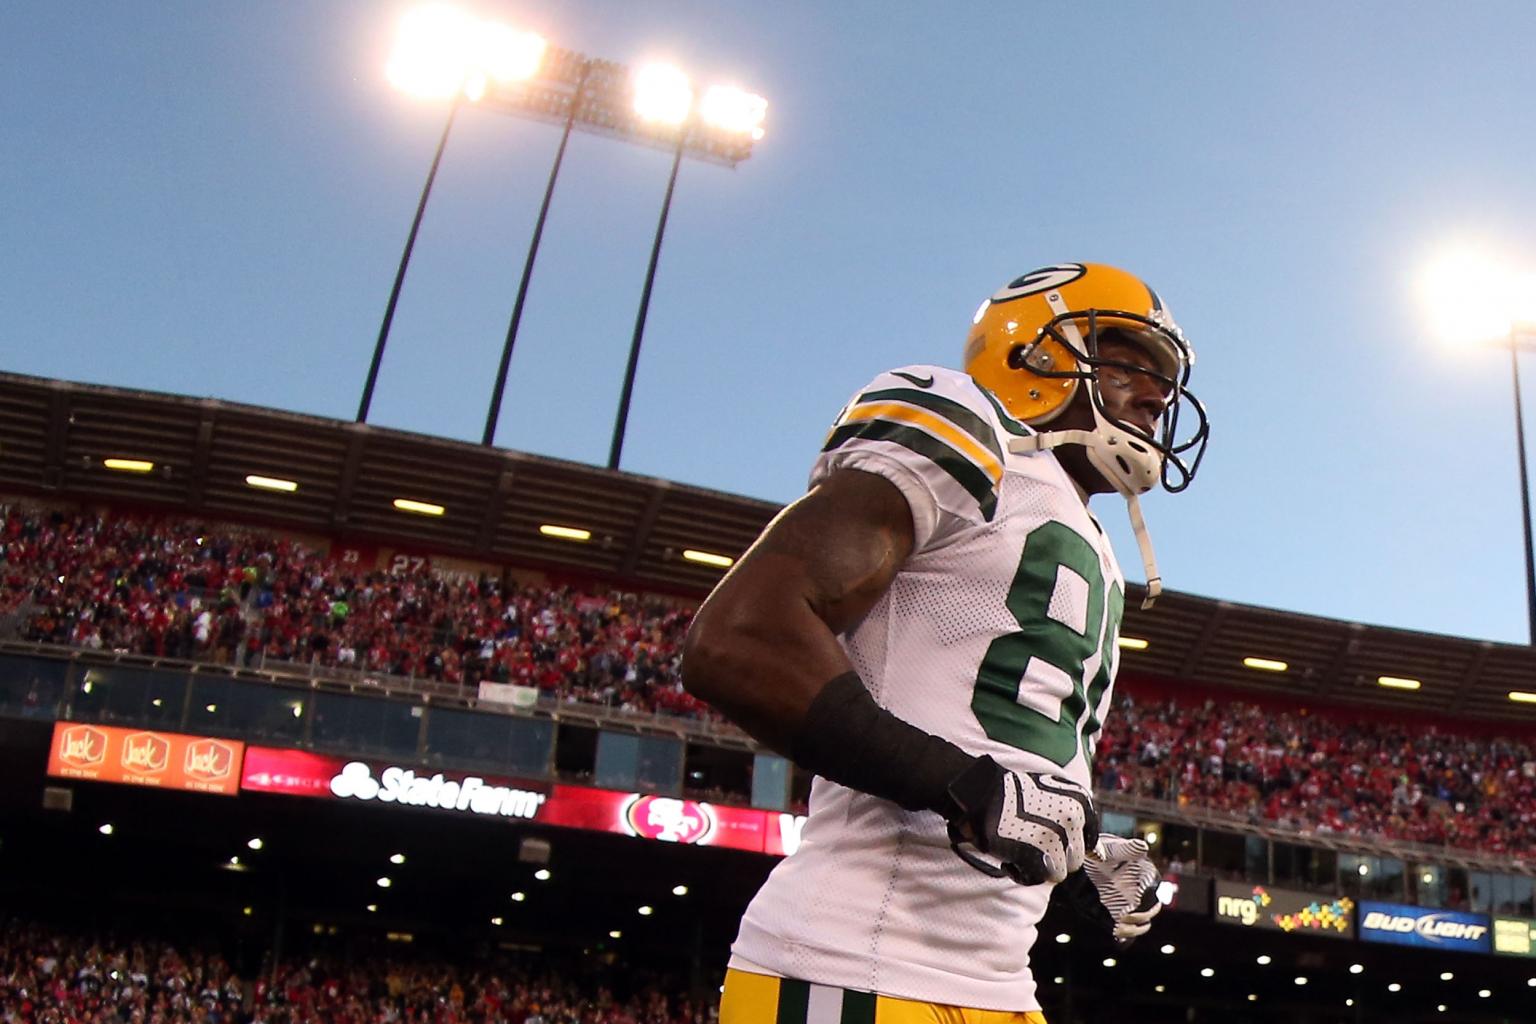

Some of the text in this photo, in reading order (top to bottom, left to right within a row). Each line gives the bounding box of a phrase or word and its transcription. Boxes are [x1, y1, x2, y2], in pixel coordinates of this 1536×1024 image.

[378, 767, 461, 810] State
[456, 777, 545, 819] Farm
[1217, 896, 1259, 925] nrg
[1363, 911, 1416, 933] BUD
[1424, 920, 1487, 941] LIGHT
